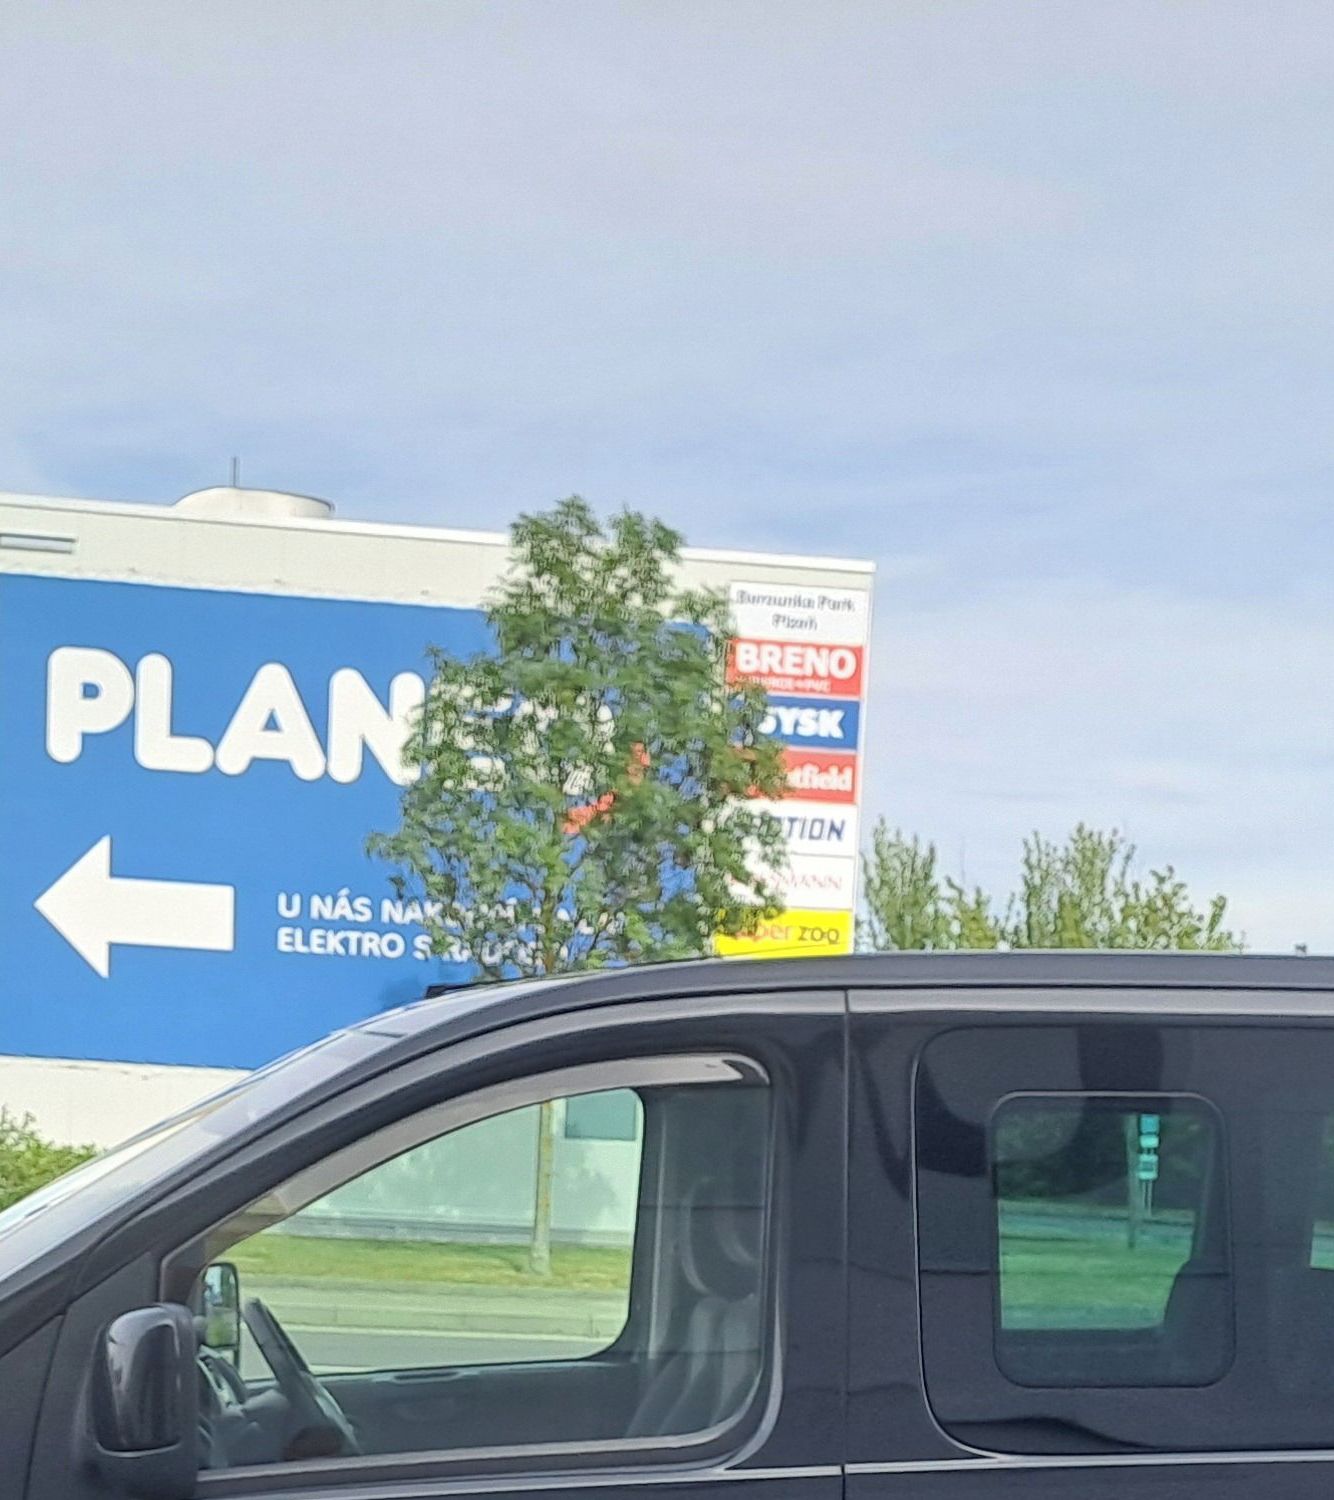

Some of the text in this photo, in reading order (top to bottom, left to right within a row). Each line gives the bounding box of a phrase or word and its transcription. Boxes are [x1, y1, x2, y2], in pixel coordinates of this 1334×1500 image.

[736, 642, 857, 680] BRENO
[47, 646, 612, 796] PLAN
[772, 816, 845, 841] TION
[277, 892, 301, 919] U
[310, 888, 373, 922] NÁS
[276, 926, 406, 959] ELEKTRO
